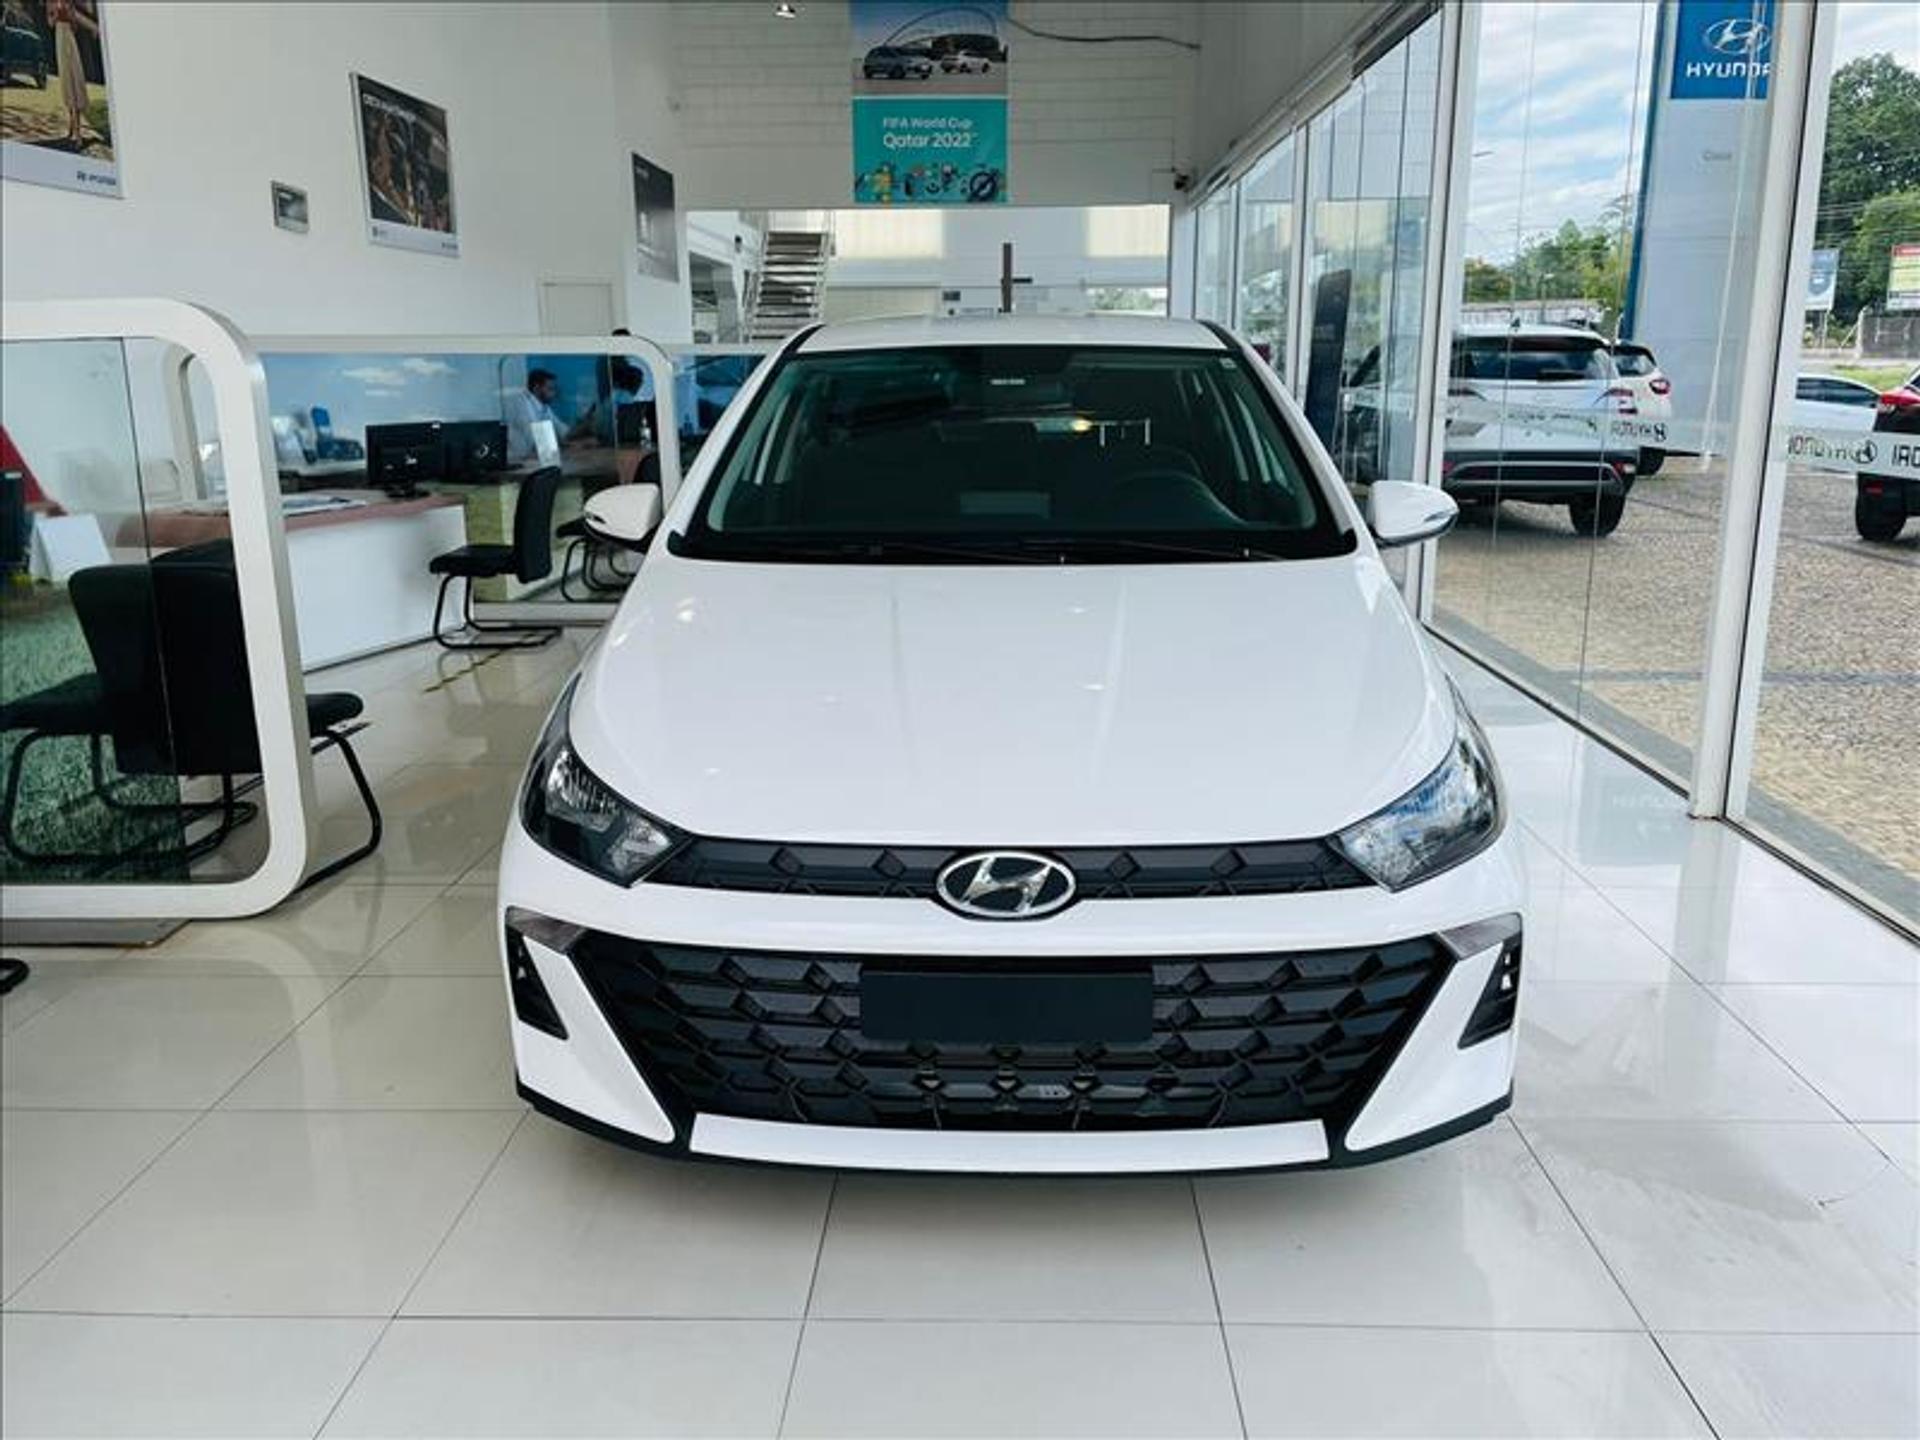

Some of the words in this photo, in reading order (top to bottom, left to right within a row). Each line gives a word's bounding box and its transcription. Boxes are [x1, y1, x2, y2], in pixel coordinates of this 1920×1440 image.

[1686, 61, 1772, 78] HYUNDA
[883, 118, 909, 128] FIFA
[911, 118, 946, 128] World
[947, 118, 973, 130] Cup
[883, 132, 929, 150] Qatar
[932, 132, 971, 148] 2022
